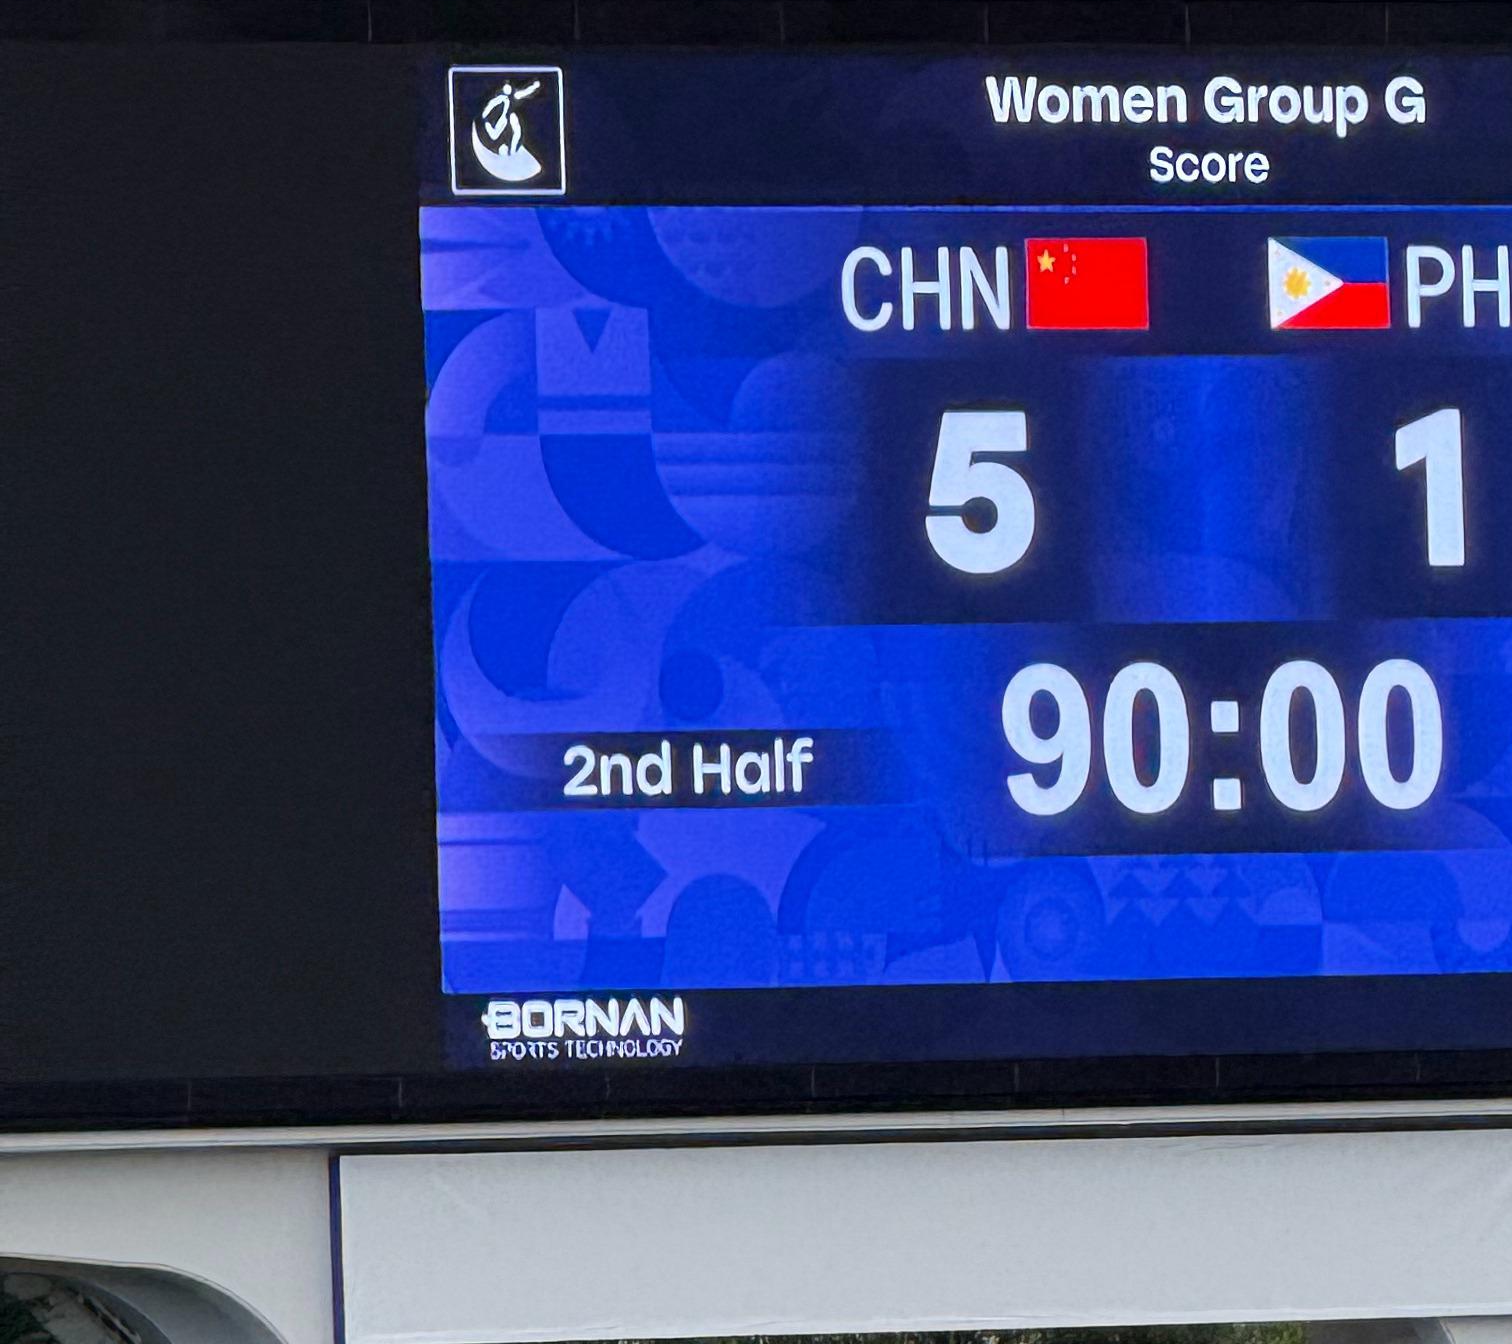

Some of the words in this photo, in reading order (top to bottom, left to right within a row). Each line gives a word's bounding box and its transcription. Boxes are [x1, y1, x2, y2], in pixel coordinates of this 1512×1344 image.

[985, 75, 1188, 124] Women
[1203, 75, 1369, 138] Group
[1384, 75, 1427, 125] G
[1149, 145, 1270, 184] Score
[841, 246, 1011, 332] CHN
[925, 411, 1035, 574] 5
[1395, 408, 1465, 567] 1
[563, 739, 673, 797] 2nd
[692, 737, 814, 795] Half
[1001, 658, 1443, 816] 90:00
[482, 996, 685, 1039] BORNAN
[490, 1041, 560, 1060] SPORTS
